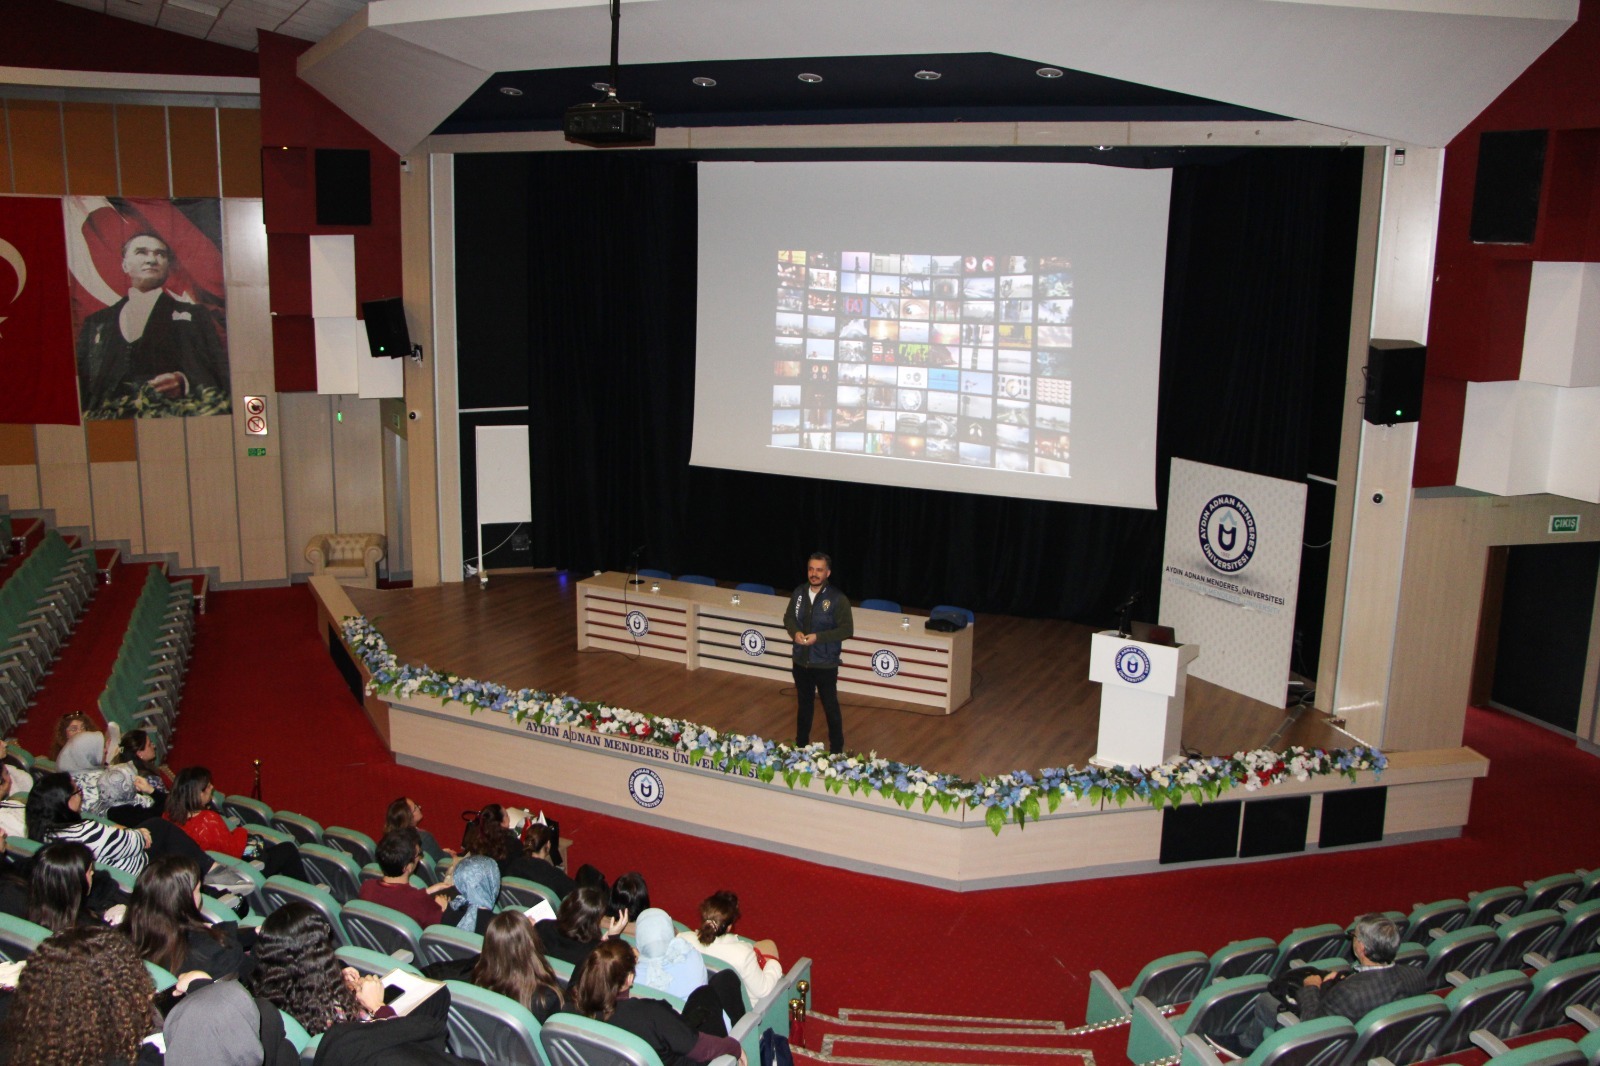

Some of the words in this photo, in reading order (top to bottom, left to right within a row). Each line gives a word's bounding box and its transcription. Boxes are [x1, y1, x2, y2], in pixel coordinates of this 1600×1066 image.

[1200, 509, 1211, 540] AYDIN
[1209, 496, 1236, 512] ADNAN
[1235, 501, 1256, 553] MENDERES
[1165, 565, 1184, 576] AYDIN
[1184, 571, 1206, 582] ADNAN
[1206, 577, 1239, 593] MENDERES
[526, 721, 560, 737] AYDIN
[562, 729, 601, 746] ADNAN
[603, 737, 669, 761] MENDERES
